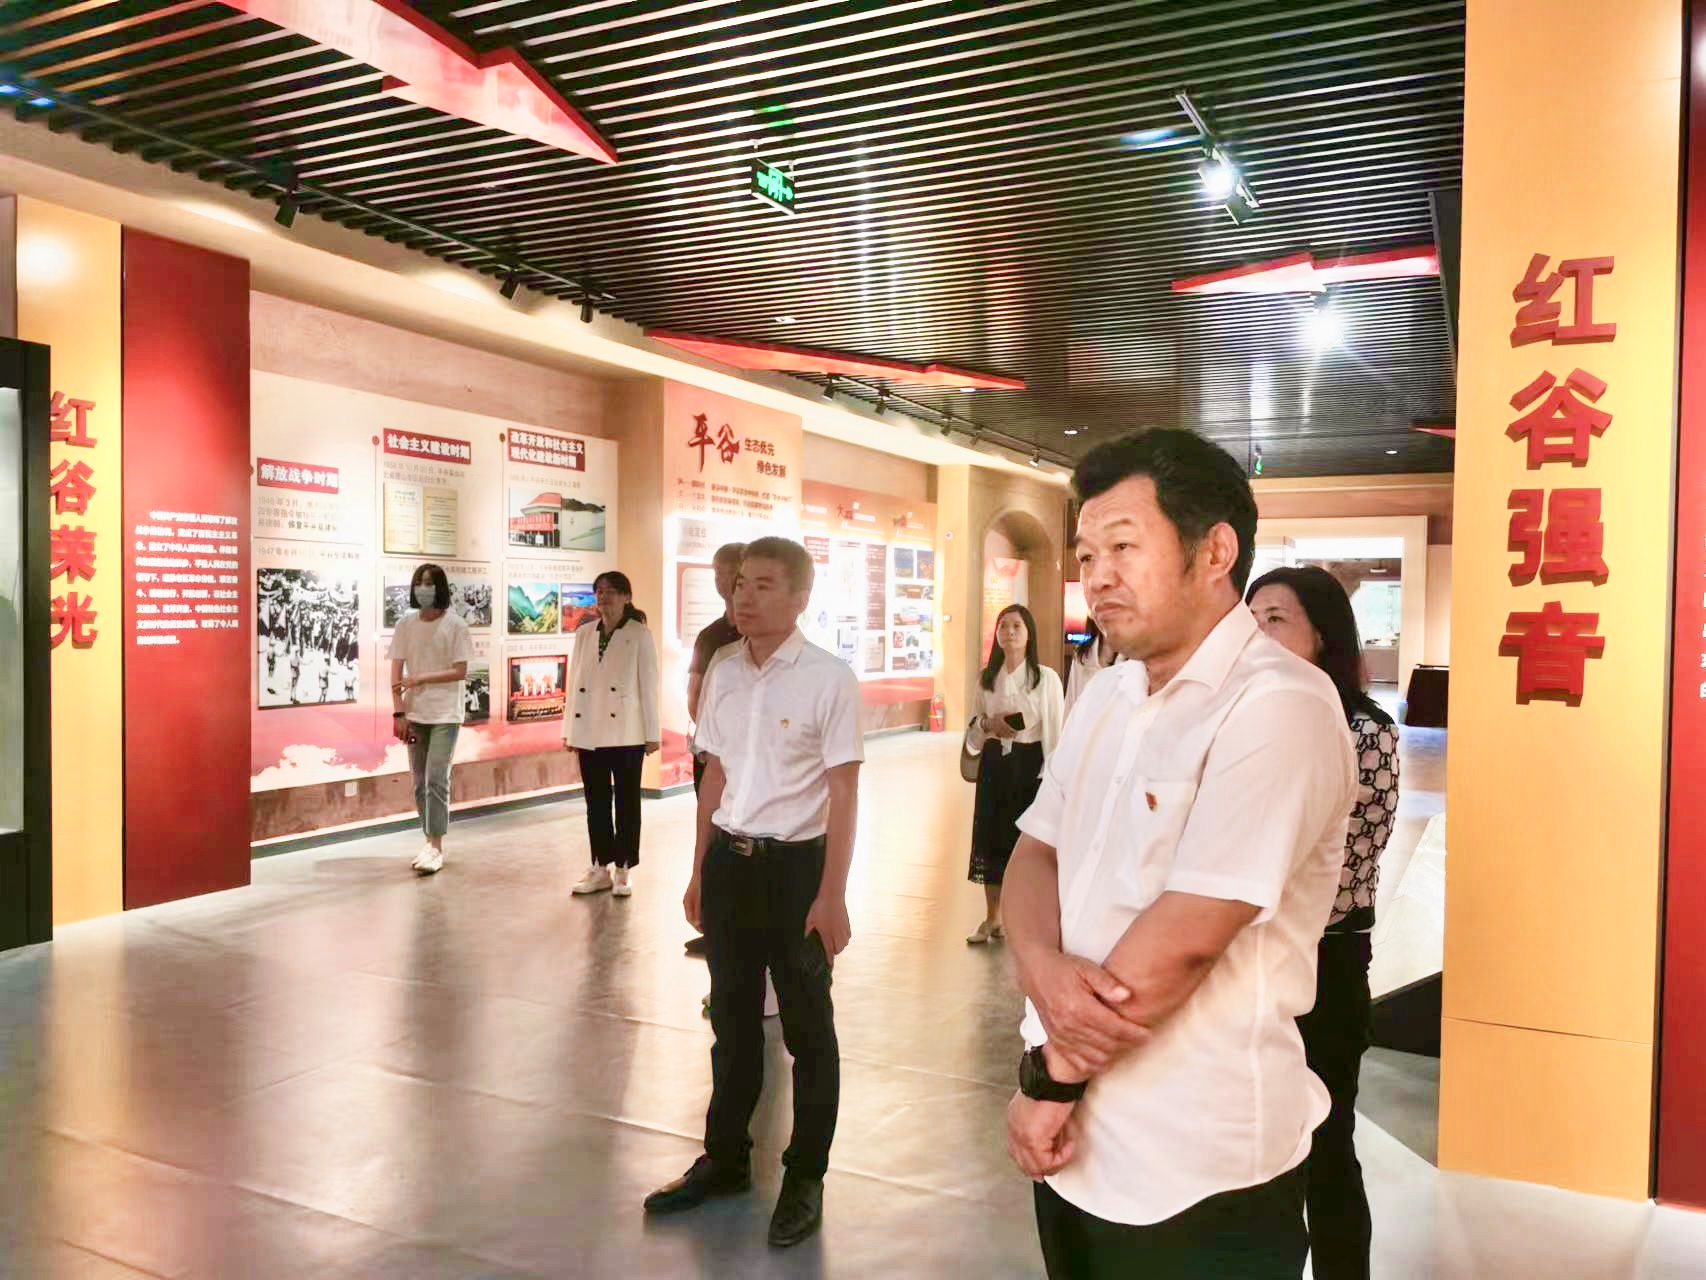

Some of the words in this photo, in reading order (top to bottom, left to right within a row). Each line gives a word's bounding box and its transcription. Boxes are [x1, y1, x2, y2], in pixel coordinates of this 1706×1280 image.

[261, 463, 338, 488] 解放战争时期
[387, 433, 470, 459] 社会主义建设时期
[1498, 253, 1617, 707] 红谷强音
[50, 390, 97, 650] 红谷荣光
